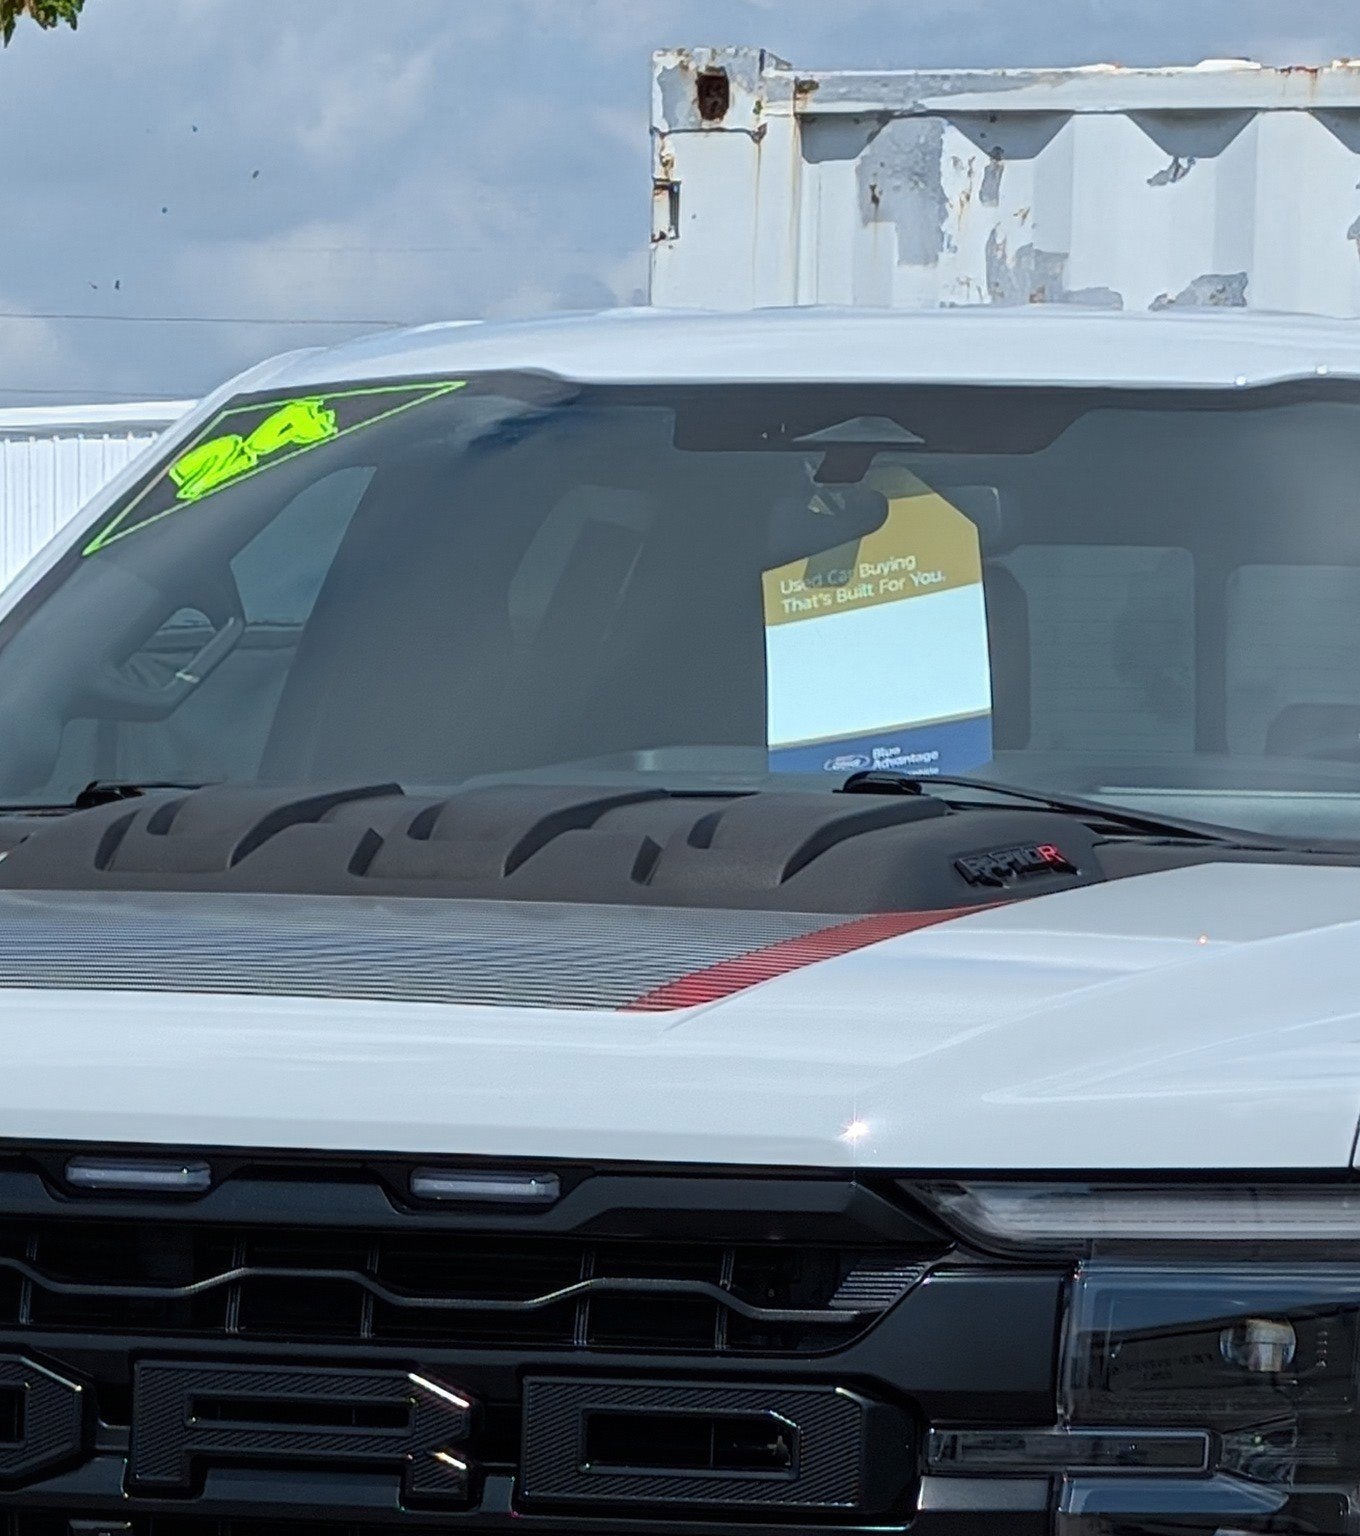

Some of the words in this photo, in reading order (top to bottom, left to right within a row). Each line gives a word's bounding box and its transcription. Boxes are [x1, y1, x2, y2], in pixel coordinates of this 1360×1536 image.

[169, 399, 339, 500] 24
[779, 573, 824, 595] Used
[827, 568, 855, 587] Car
[859, 554, 918, 580] Buying
[780, 592, 833, 614] That's
[836, 582, 875, 605] Built
[878, 577, 907, 595] For
[872, 746, 902, 760] Blue
[872, 751, 939, 771] Advantage
[955, 843, 1071, 885] RAPTOR
